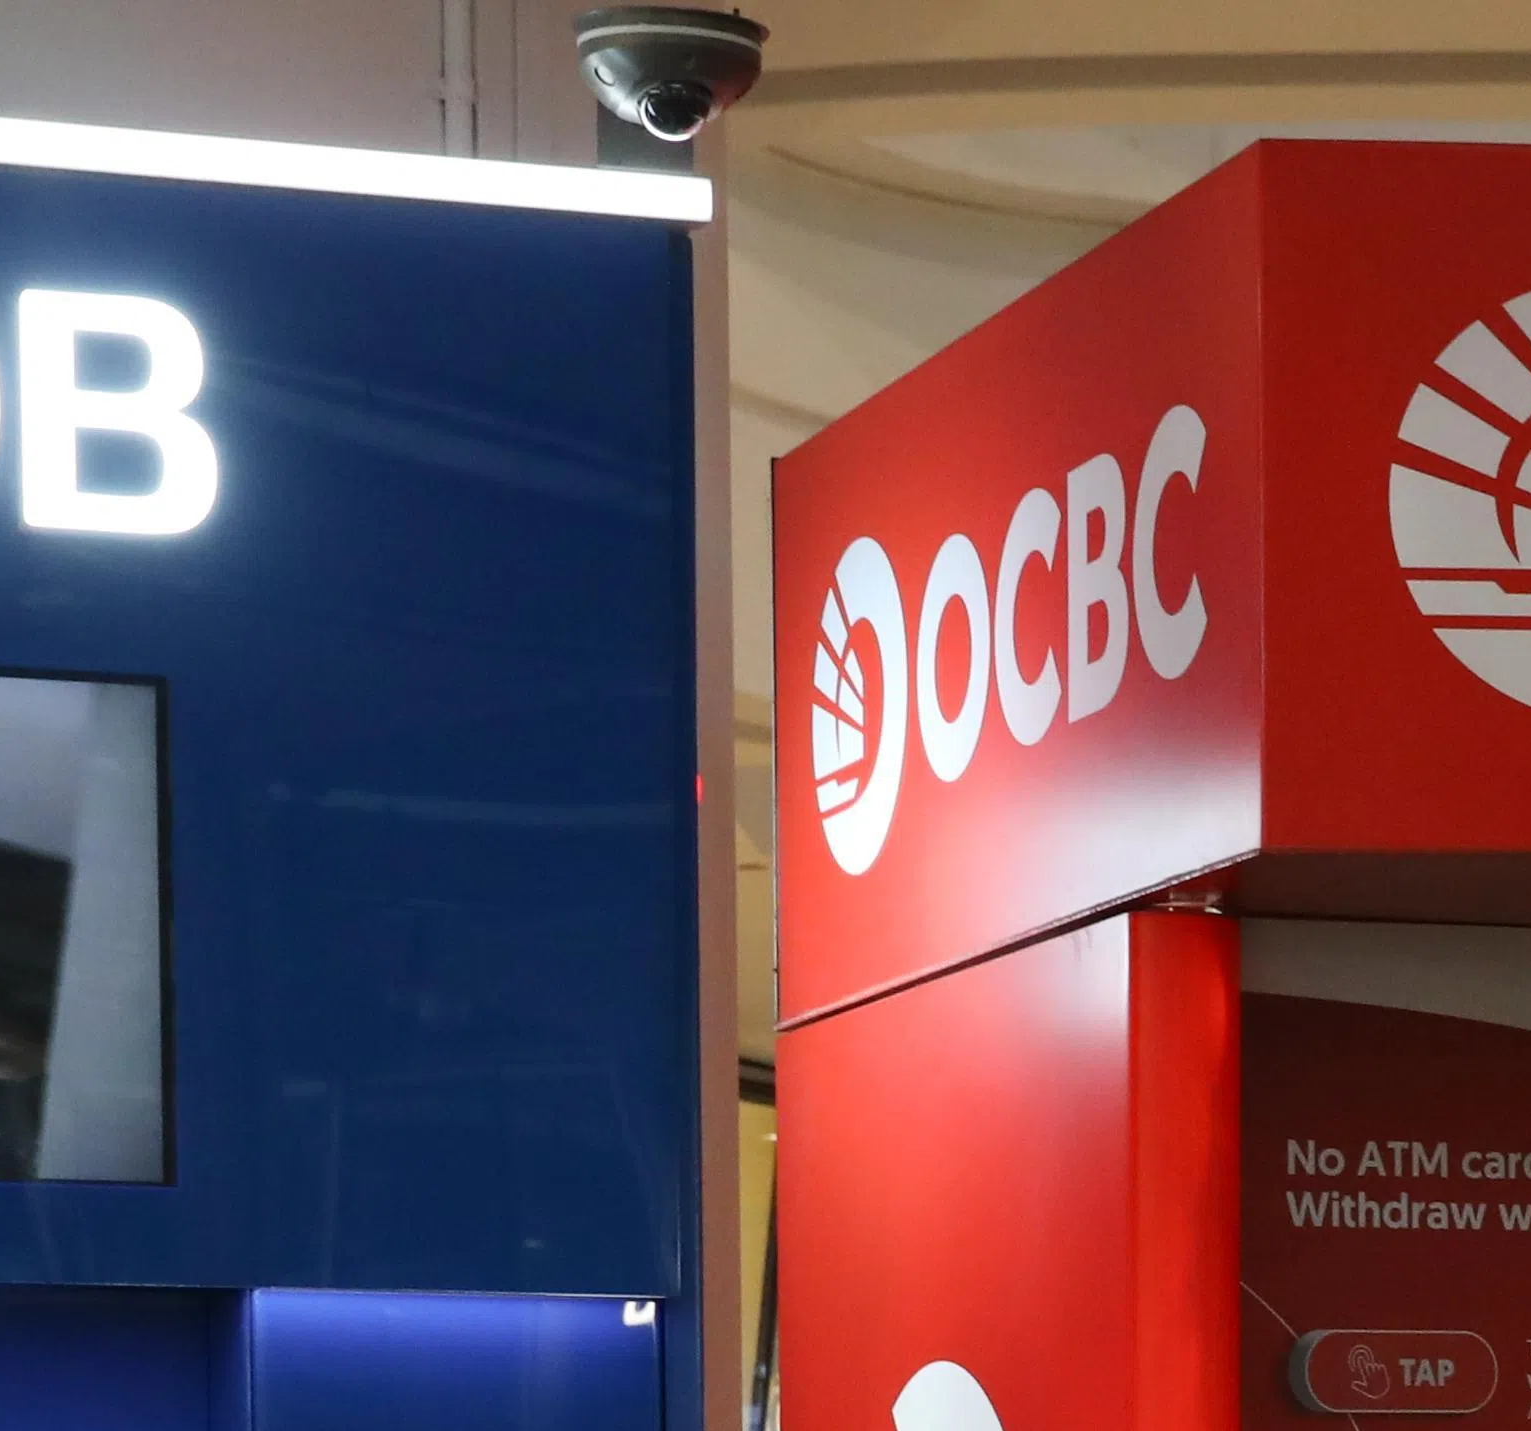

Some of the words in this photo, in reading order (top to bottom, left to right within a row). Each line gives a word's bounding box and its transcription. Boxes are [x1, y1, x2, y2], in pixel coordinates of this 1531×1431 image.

[917, 404, 1207, 782] OCBC
[1287, 1139, 1345, 1177] No
[1357, 1142, 1449, 1178] ATM
[1287, 1191, 1487, 1231] Withdraw
[1398, 1357, 1455, 1387] TAP
